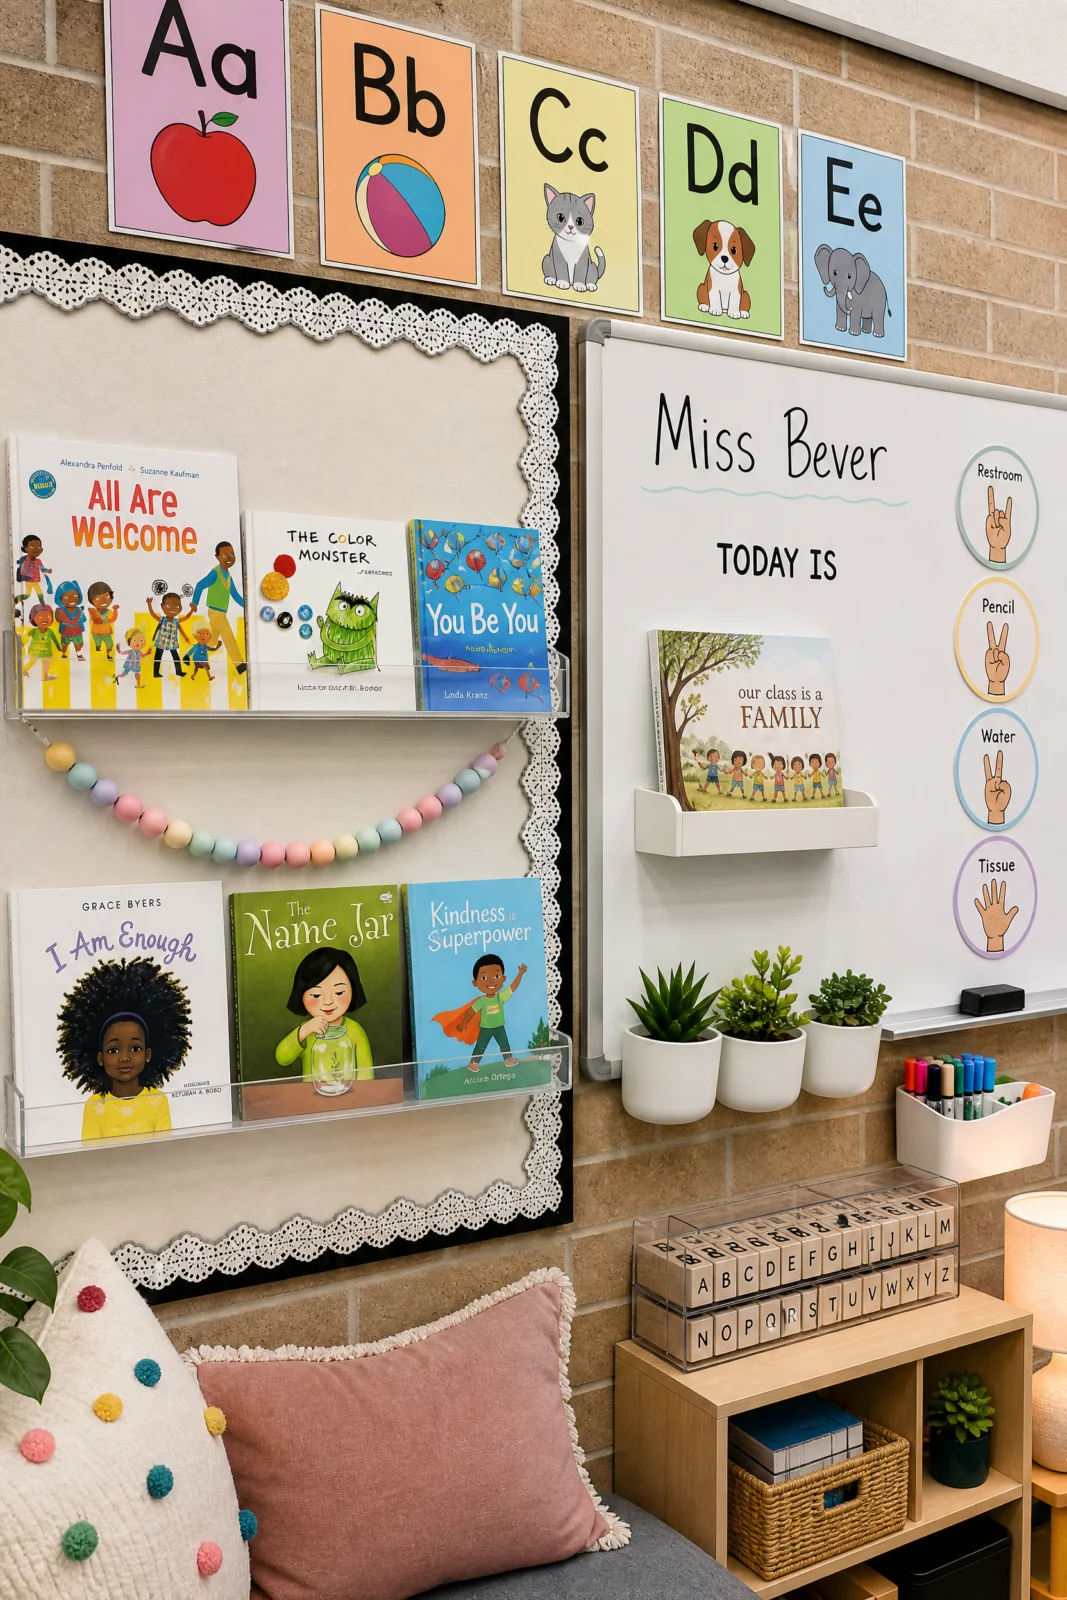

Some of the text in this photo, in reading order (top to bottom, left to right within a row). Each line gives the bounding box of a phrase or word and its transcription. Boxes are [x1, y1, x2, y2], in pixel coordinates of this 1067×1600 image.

[142, 0, 257, 99] Aa
[353, 42, 446, 138] Bb
[529, 87, 609, 172] Cc
[687, 122, 759, 206] Dd
[826, 156, 883, 232] Ee
[655, 392, 888, 481] Miss Bever
[60, 458, 96, 470] Alexandra
[96, 462, 123, 471] Penfold
[140, 466, 169, 477] Suzanne
[170, 469, 200, 479] Kaufman
[977, 463, 1023, 482] Restroom
[88, 479, 120, 512] All
[129, 483, 178, 518] Are
[71, 515, 198, 555] Welcome
[287, 530, 377, 547] THE COLOR
[298, 549, 370, 564] MONSTER
[716, 542, 837, 581] TODAY IS
[426, 602, 539, 636] You Be You
[982, 598, 1015, 615] Pencil
[738, 684, 823, 700] our class is a
[740, 705, 823, 729] FAMILY
[981, 728, 1016, 743] Water
[978, 858, 1016, 874] Tissue
[82, 898, 162, 911] GRACE BYERS
[287, 901, 311, 917] The
[430, 900, 505, 928] Kindness
[244, 902, 394, 956] Name Jar
[45, 920, 197, 974] I Am Enough
[697, 1219, 951, 1295] A B C D E F G H I J K L M
[698, 1268, 950, 1348] N O P Q R S T U V W X Y Z
